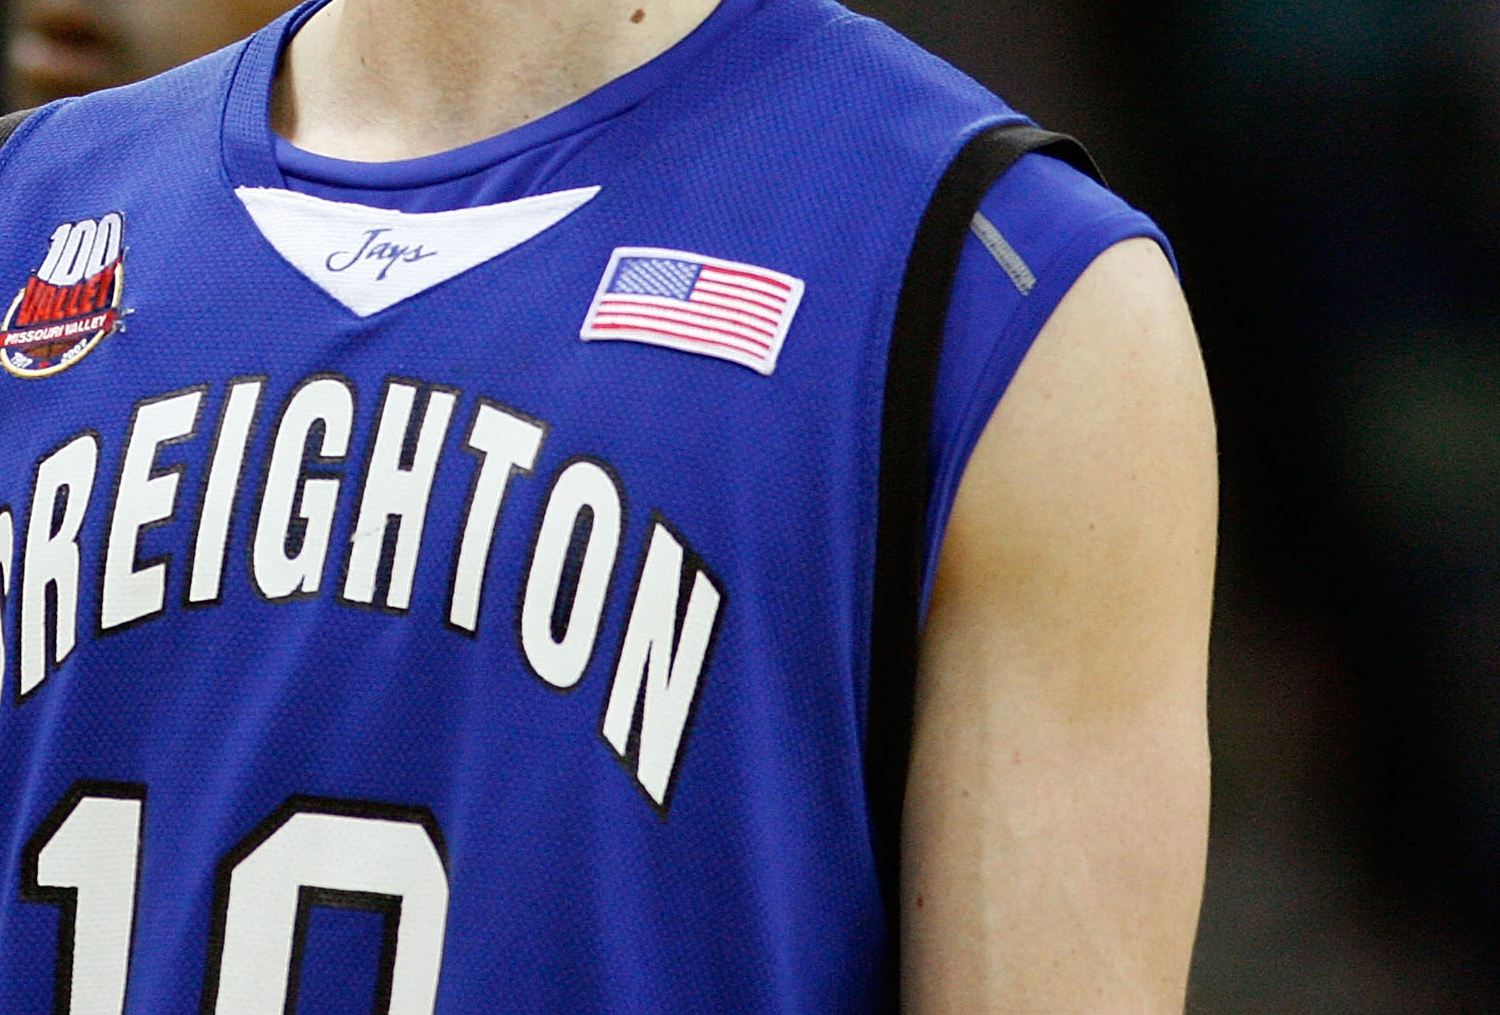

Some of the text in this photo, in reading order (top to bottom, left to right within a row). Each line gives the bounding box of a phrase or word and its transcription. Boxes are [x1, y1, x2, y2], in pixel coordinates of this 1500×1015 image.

[36, 212, 122, 287] 100
[326, 228, 438, 281] Jays
[4, 314, 108, 346] MISSOURI VALLEY
[23, 783, 450, 1015] 10
